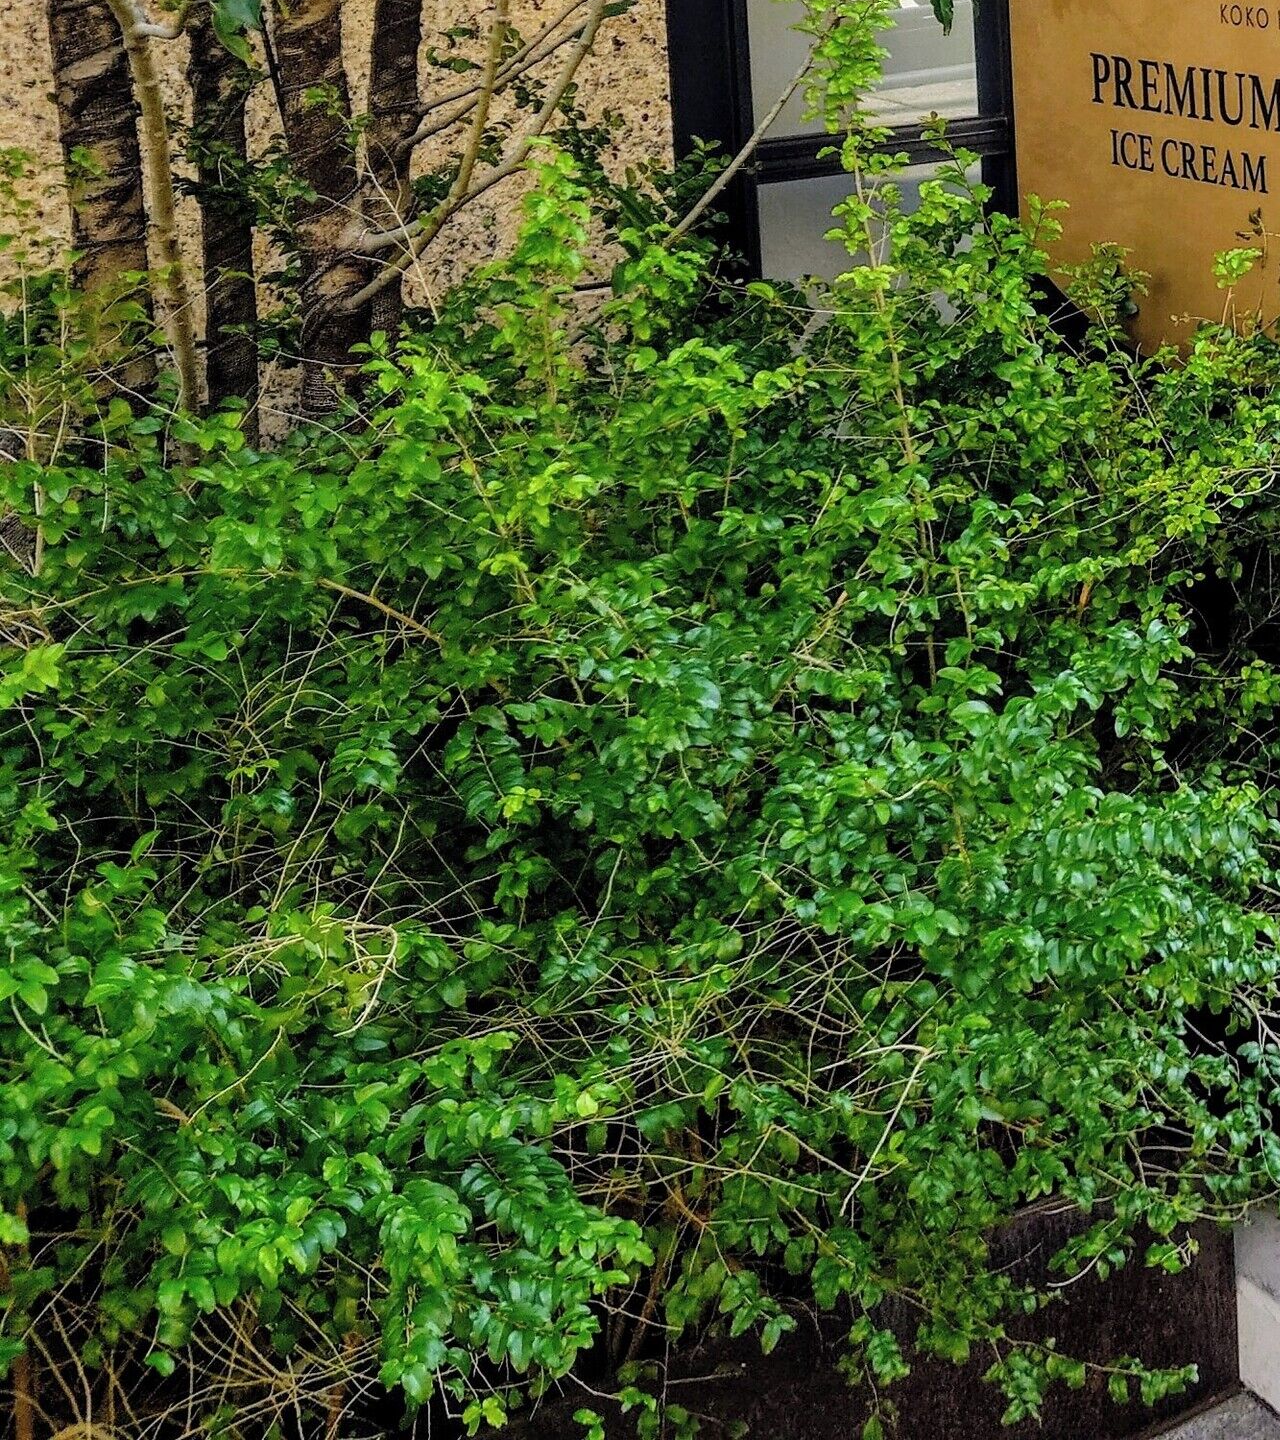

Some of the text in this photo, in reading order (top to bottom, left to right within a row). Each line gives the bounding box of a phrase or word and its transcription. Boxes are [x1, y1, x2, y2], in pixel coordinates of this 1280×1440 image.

[1220, 3, 1269, 30] KOKO
[1110, 128, 1269, 195] ICE CREAM
